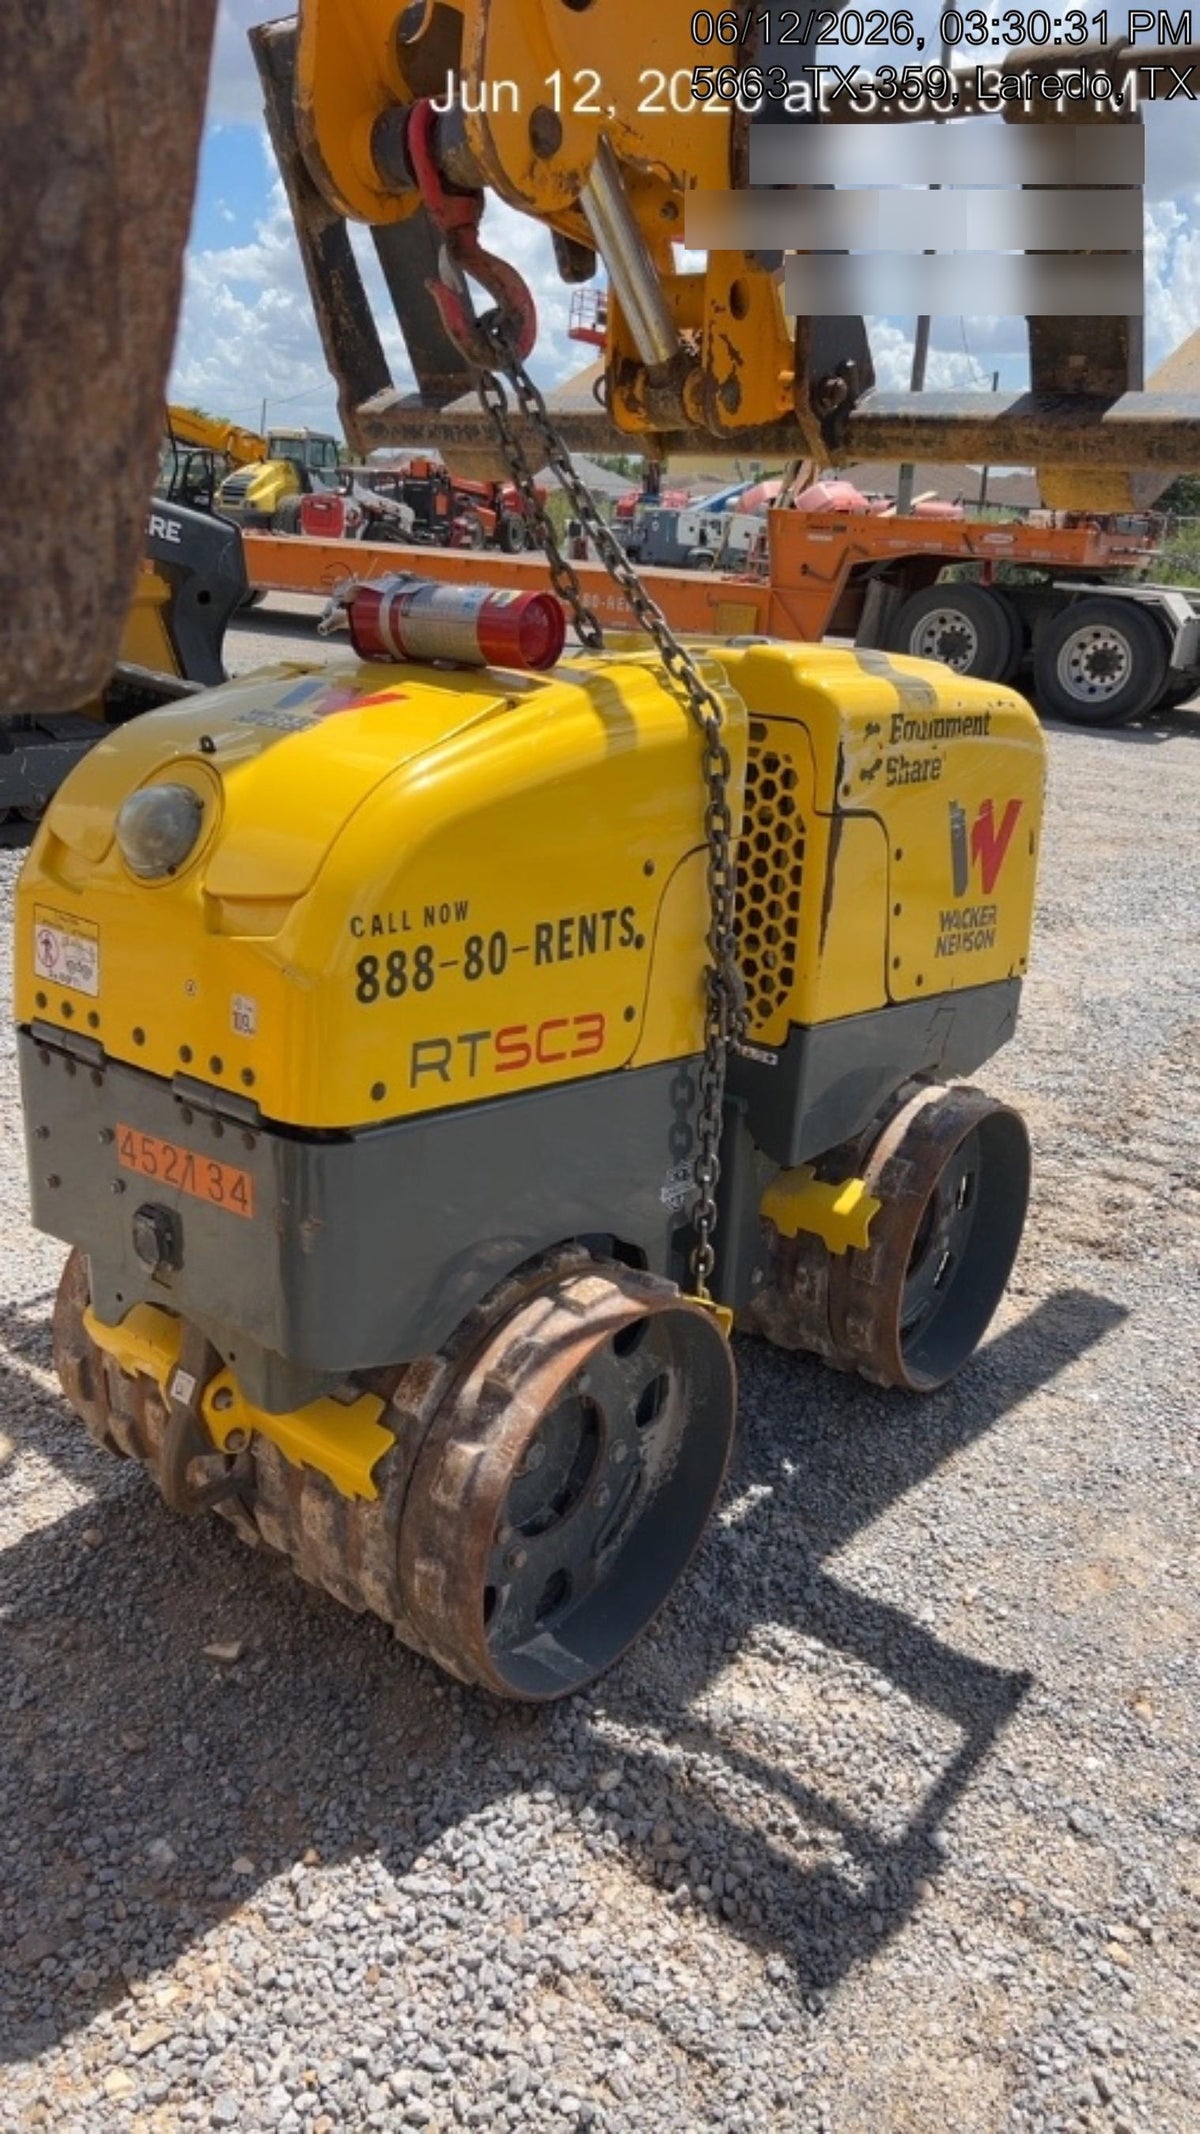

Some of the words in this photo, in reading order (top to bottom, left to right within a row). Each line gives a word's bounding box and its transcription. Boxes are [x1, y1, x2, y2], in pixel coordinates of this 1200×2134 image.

[886, 754, 942, 787] Share
[351, 910, 412, 937] CALL
[424, 900, 469, 927] NOW
[939, 905, 997, 932] WACKER
[356, 906, 637, 1004] 888-80-RENTS
[934, 926, 996, 958] NEUSON
[409, 1013, 605, 1089] RTSC3
